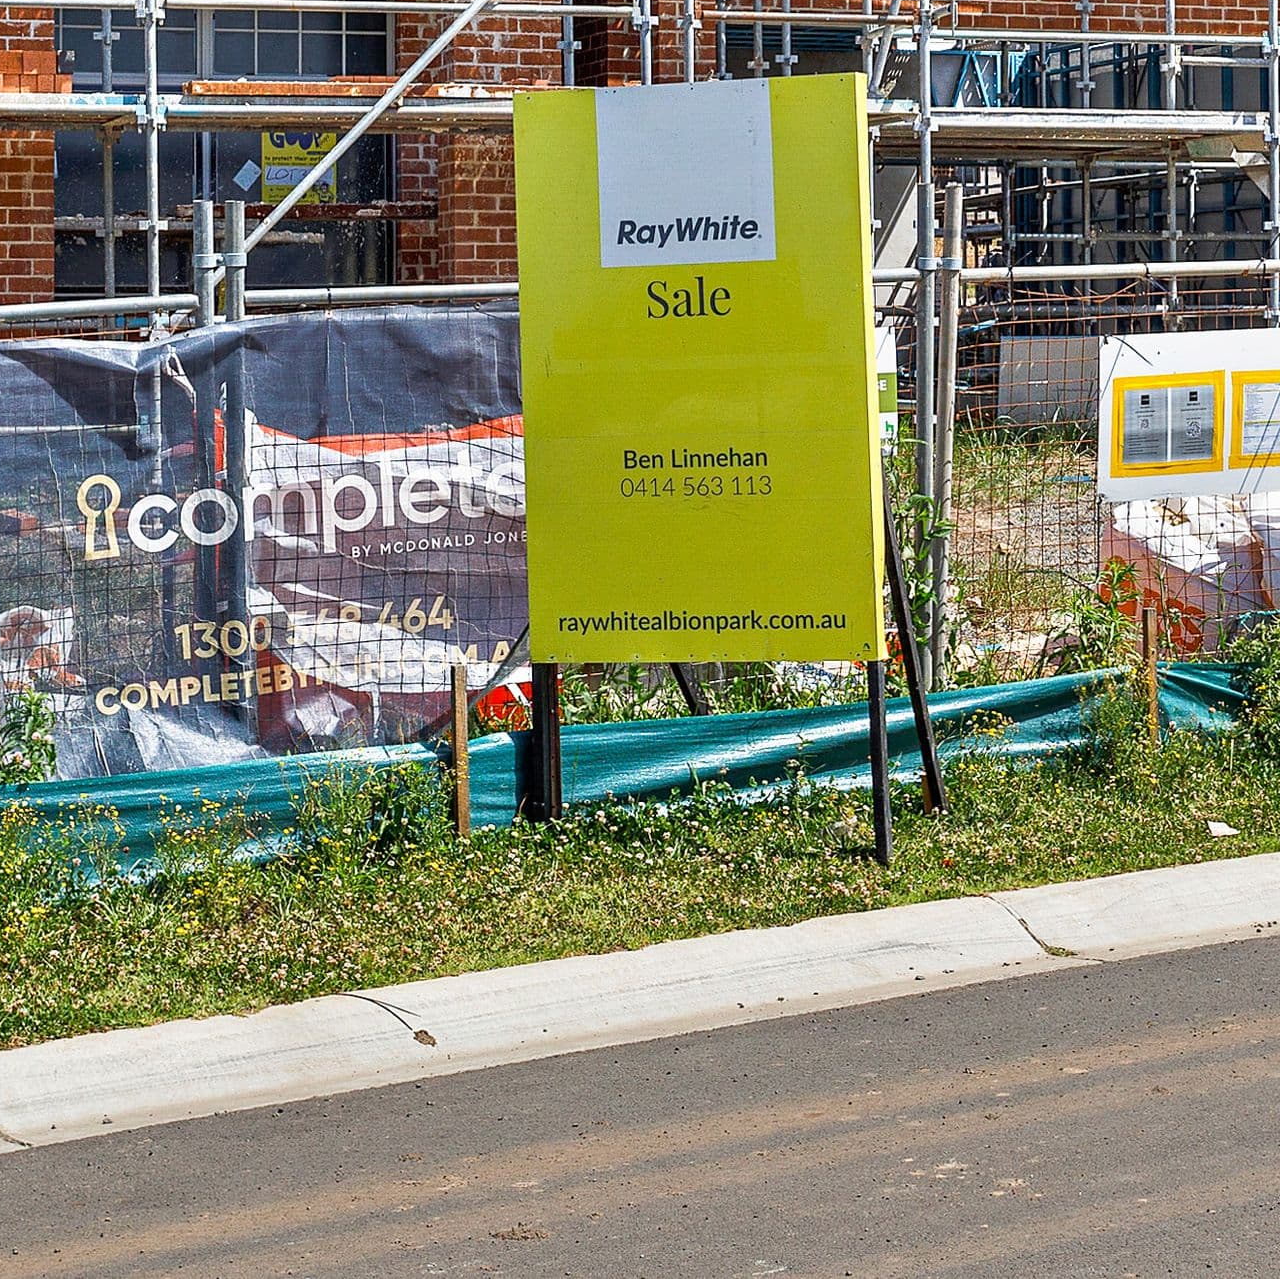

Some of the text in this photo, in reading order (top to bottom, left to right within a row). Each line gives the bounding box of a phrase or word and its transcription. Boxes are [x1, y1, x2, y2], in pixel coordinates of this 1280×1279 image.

[617, 215, 758, 248] RayWhite
[647, 276, 731, 318] Sale
[624, 447, 768, 469] Ben Linnehan
[620, 475, 772, 498] 0414 563 113
[126, 449, 527, 554] complete
[351, 545, 372, 558] BY
[380, 533, 475, 555] MCDONALD
[175, 616, 271, 661] 1300
[378, 595, 455, 636] 464
[559, 610, 847, 635] raywhitealbionpark.com.au
